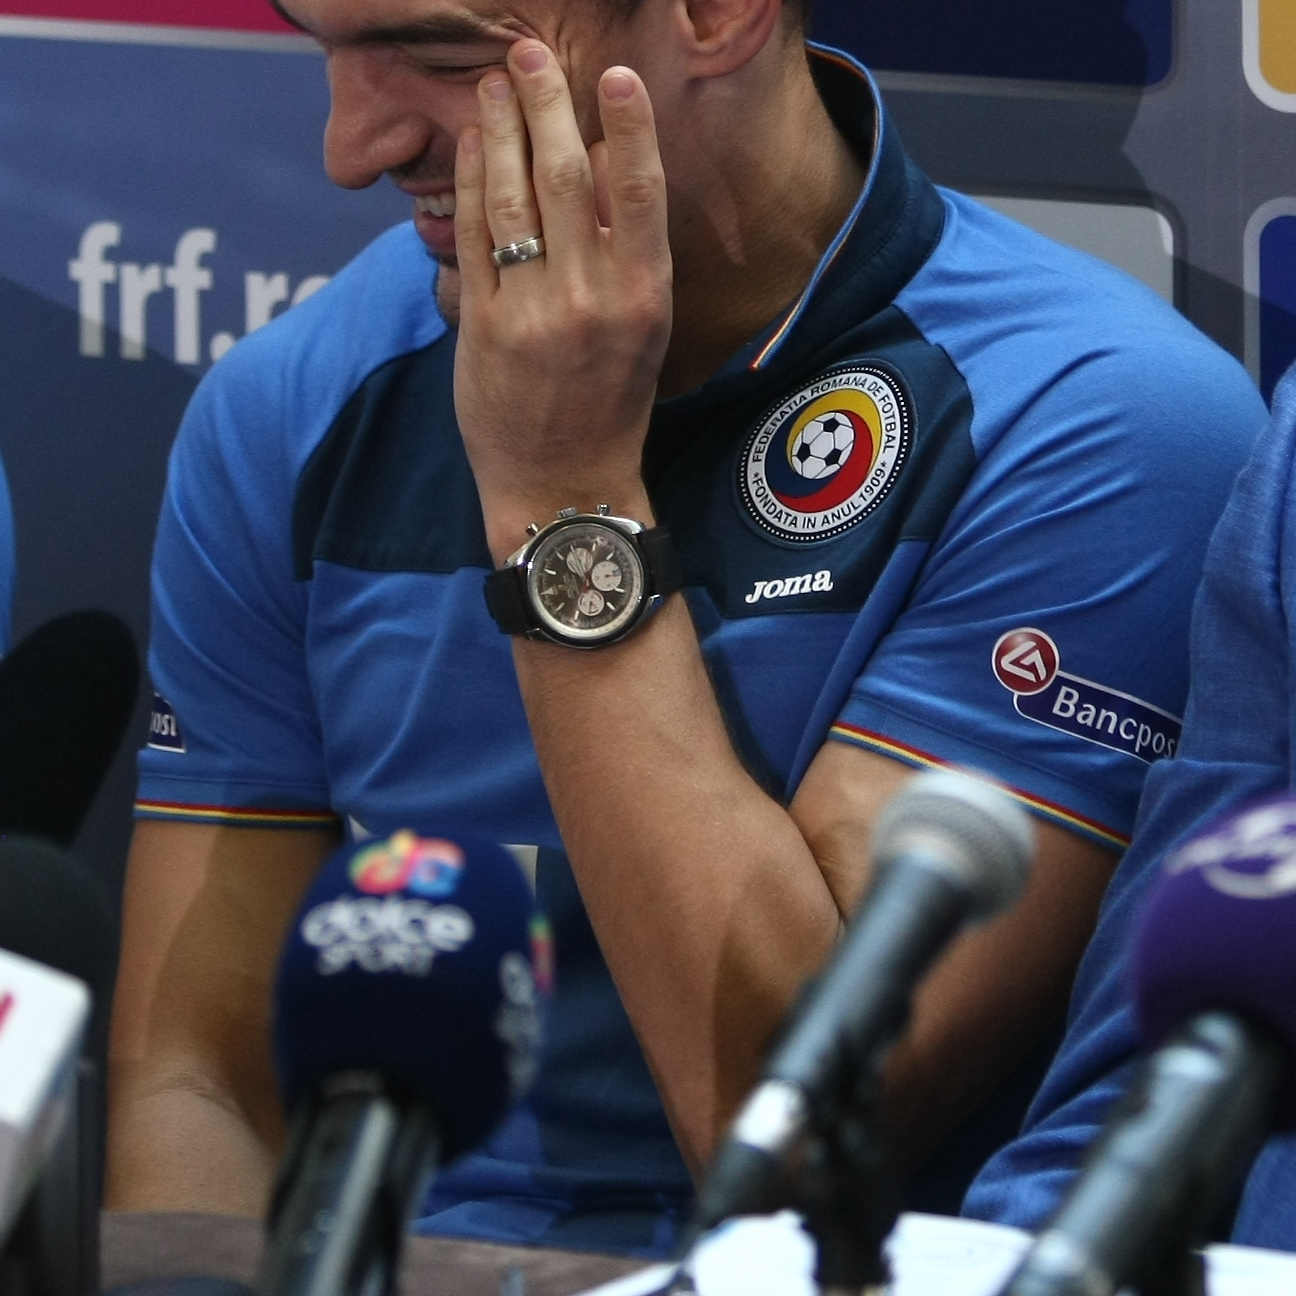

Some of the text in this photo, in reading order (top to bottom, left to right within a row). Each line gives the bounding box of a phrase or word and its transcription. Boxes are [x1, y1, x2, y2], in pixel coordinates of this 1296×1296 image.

[68, 220, 329, 365] frf.r
[867, 380, 883, 397] DE
[878, 393, 897, 454] FOTBAL
[803, 516, 816, 529] IN
[820, 501, 865, 527] ANUL
[859, 468, 886, 502] 1909
